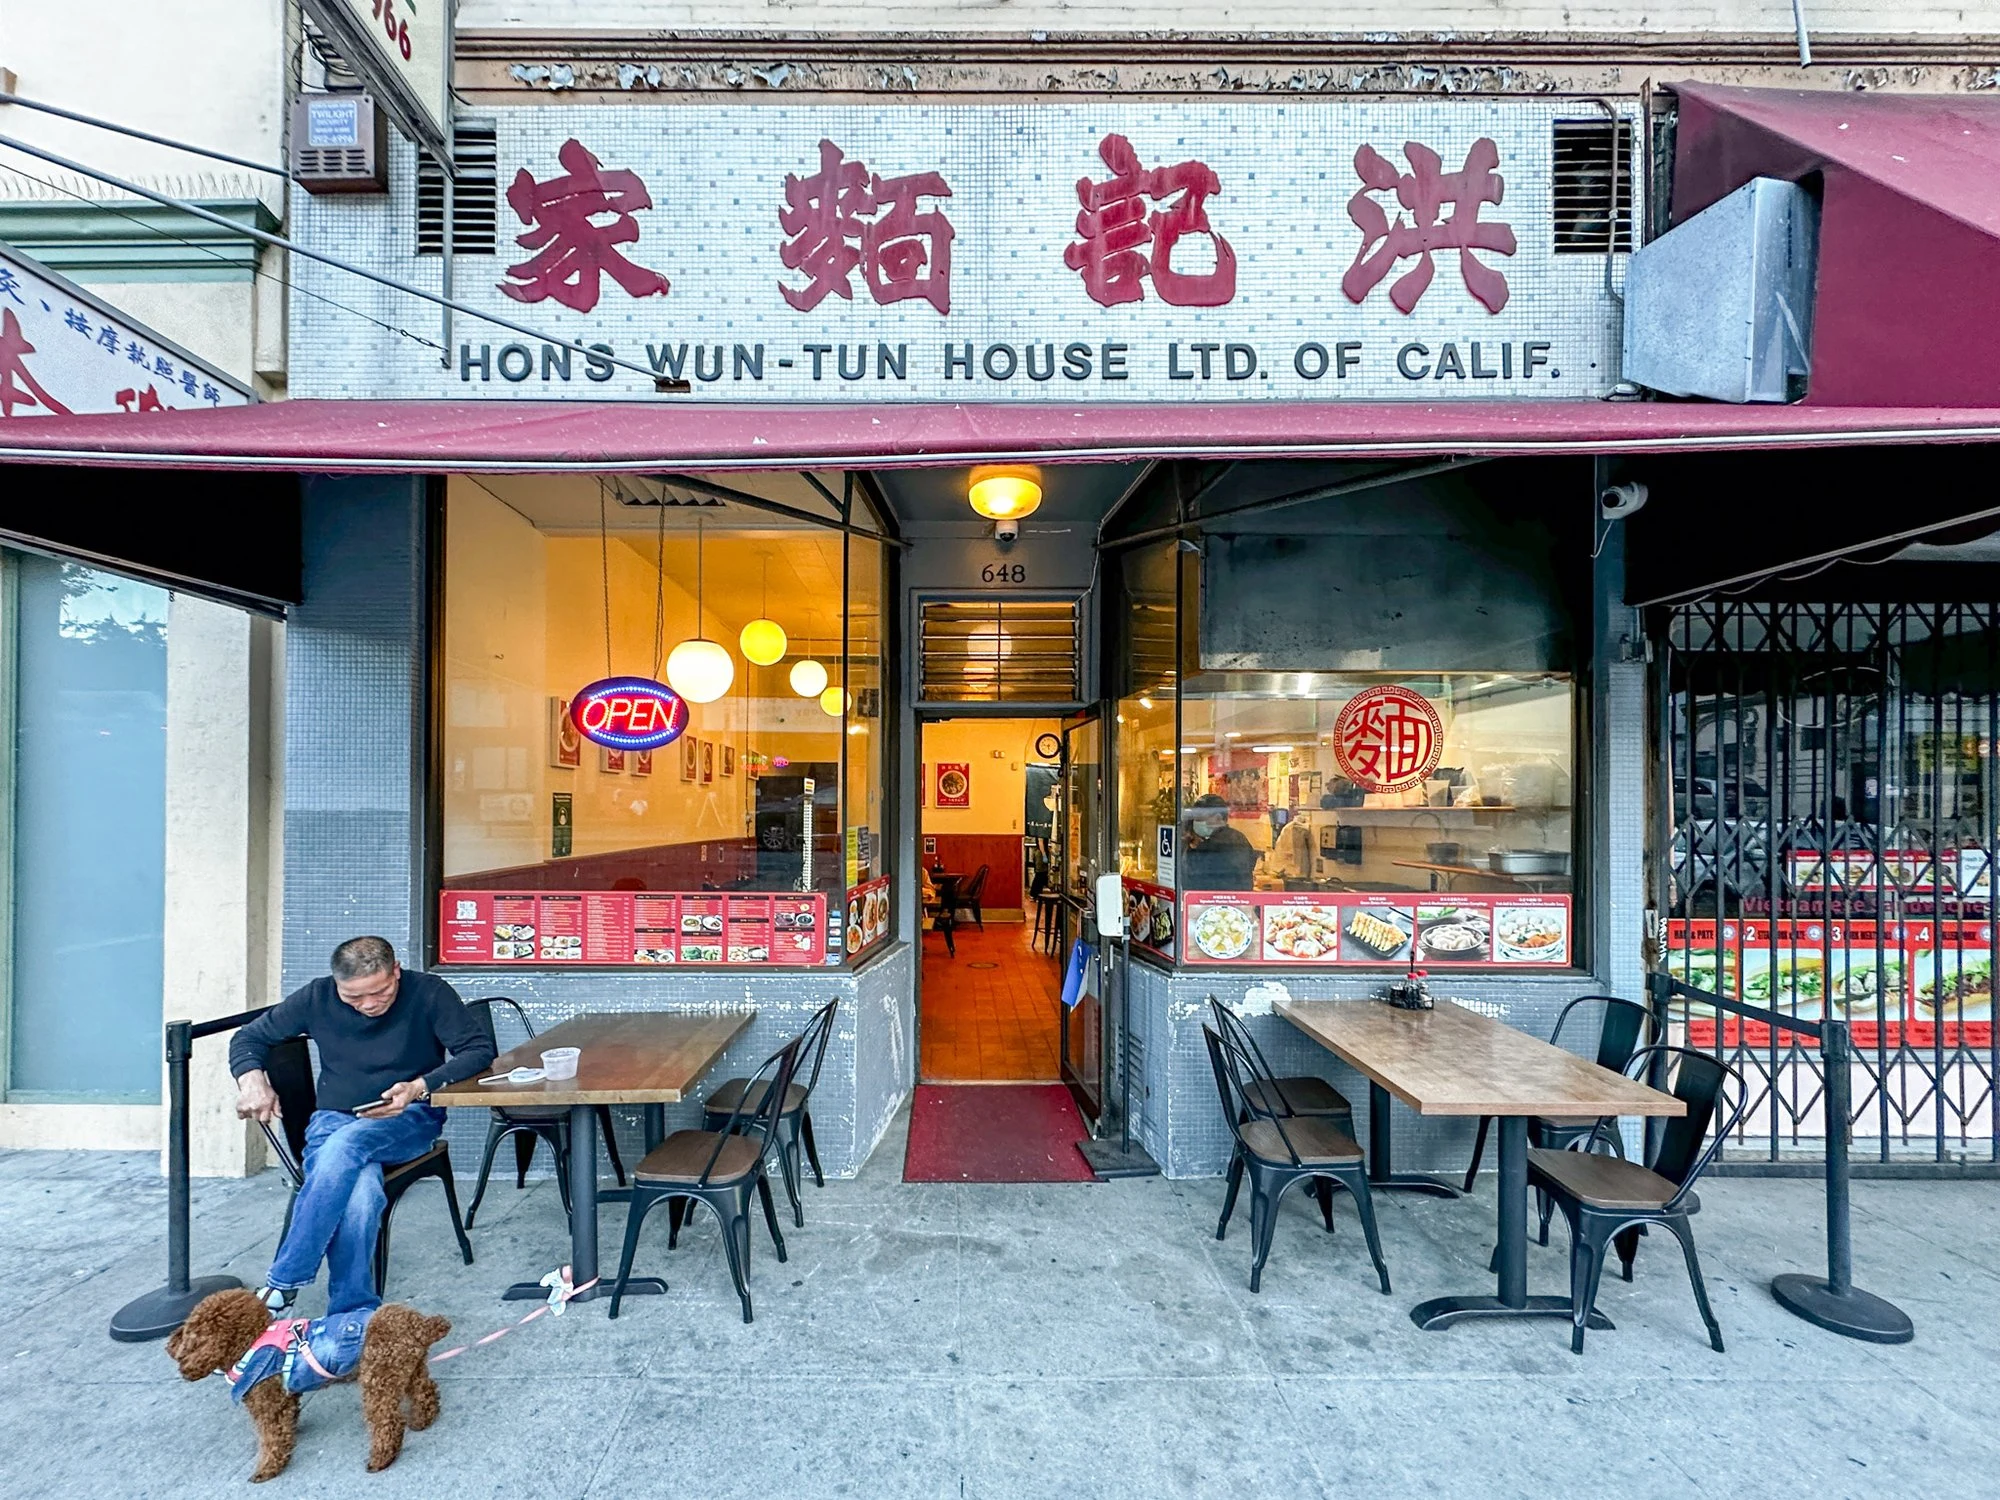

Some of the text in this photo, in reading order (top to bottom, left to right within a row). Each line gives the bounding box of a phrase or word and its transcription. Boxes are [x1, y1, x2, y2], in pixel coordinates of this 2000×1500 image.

[312, 110, 354, 119] TWILIGHT
[461, 337, 1559, 382] HON'S WUN-TUN HOUSE LTD. OF CALIF.
[982, 564, 1026, 583] 648
[582, 698, 677, 732] OPEN
[1674, 930, 1689, 940] HA
[1831, 926, 1842, 941] 3
